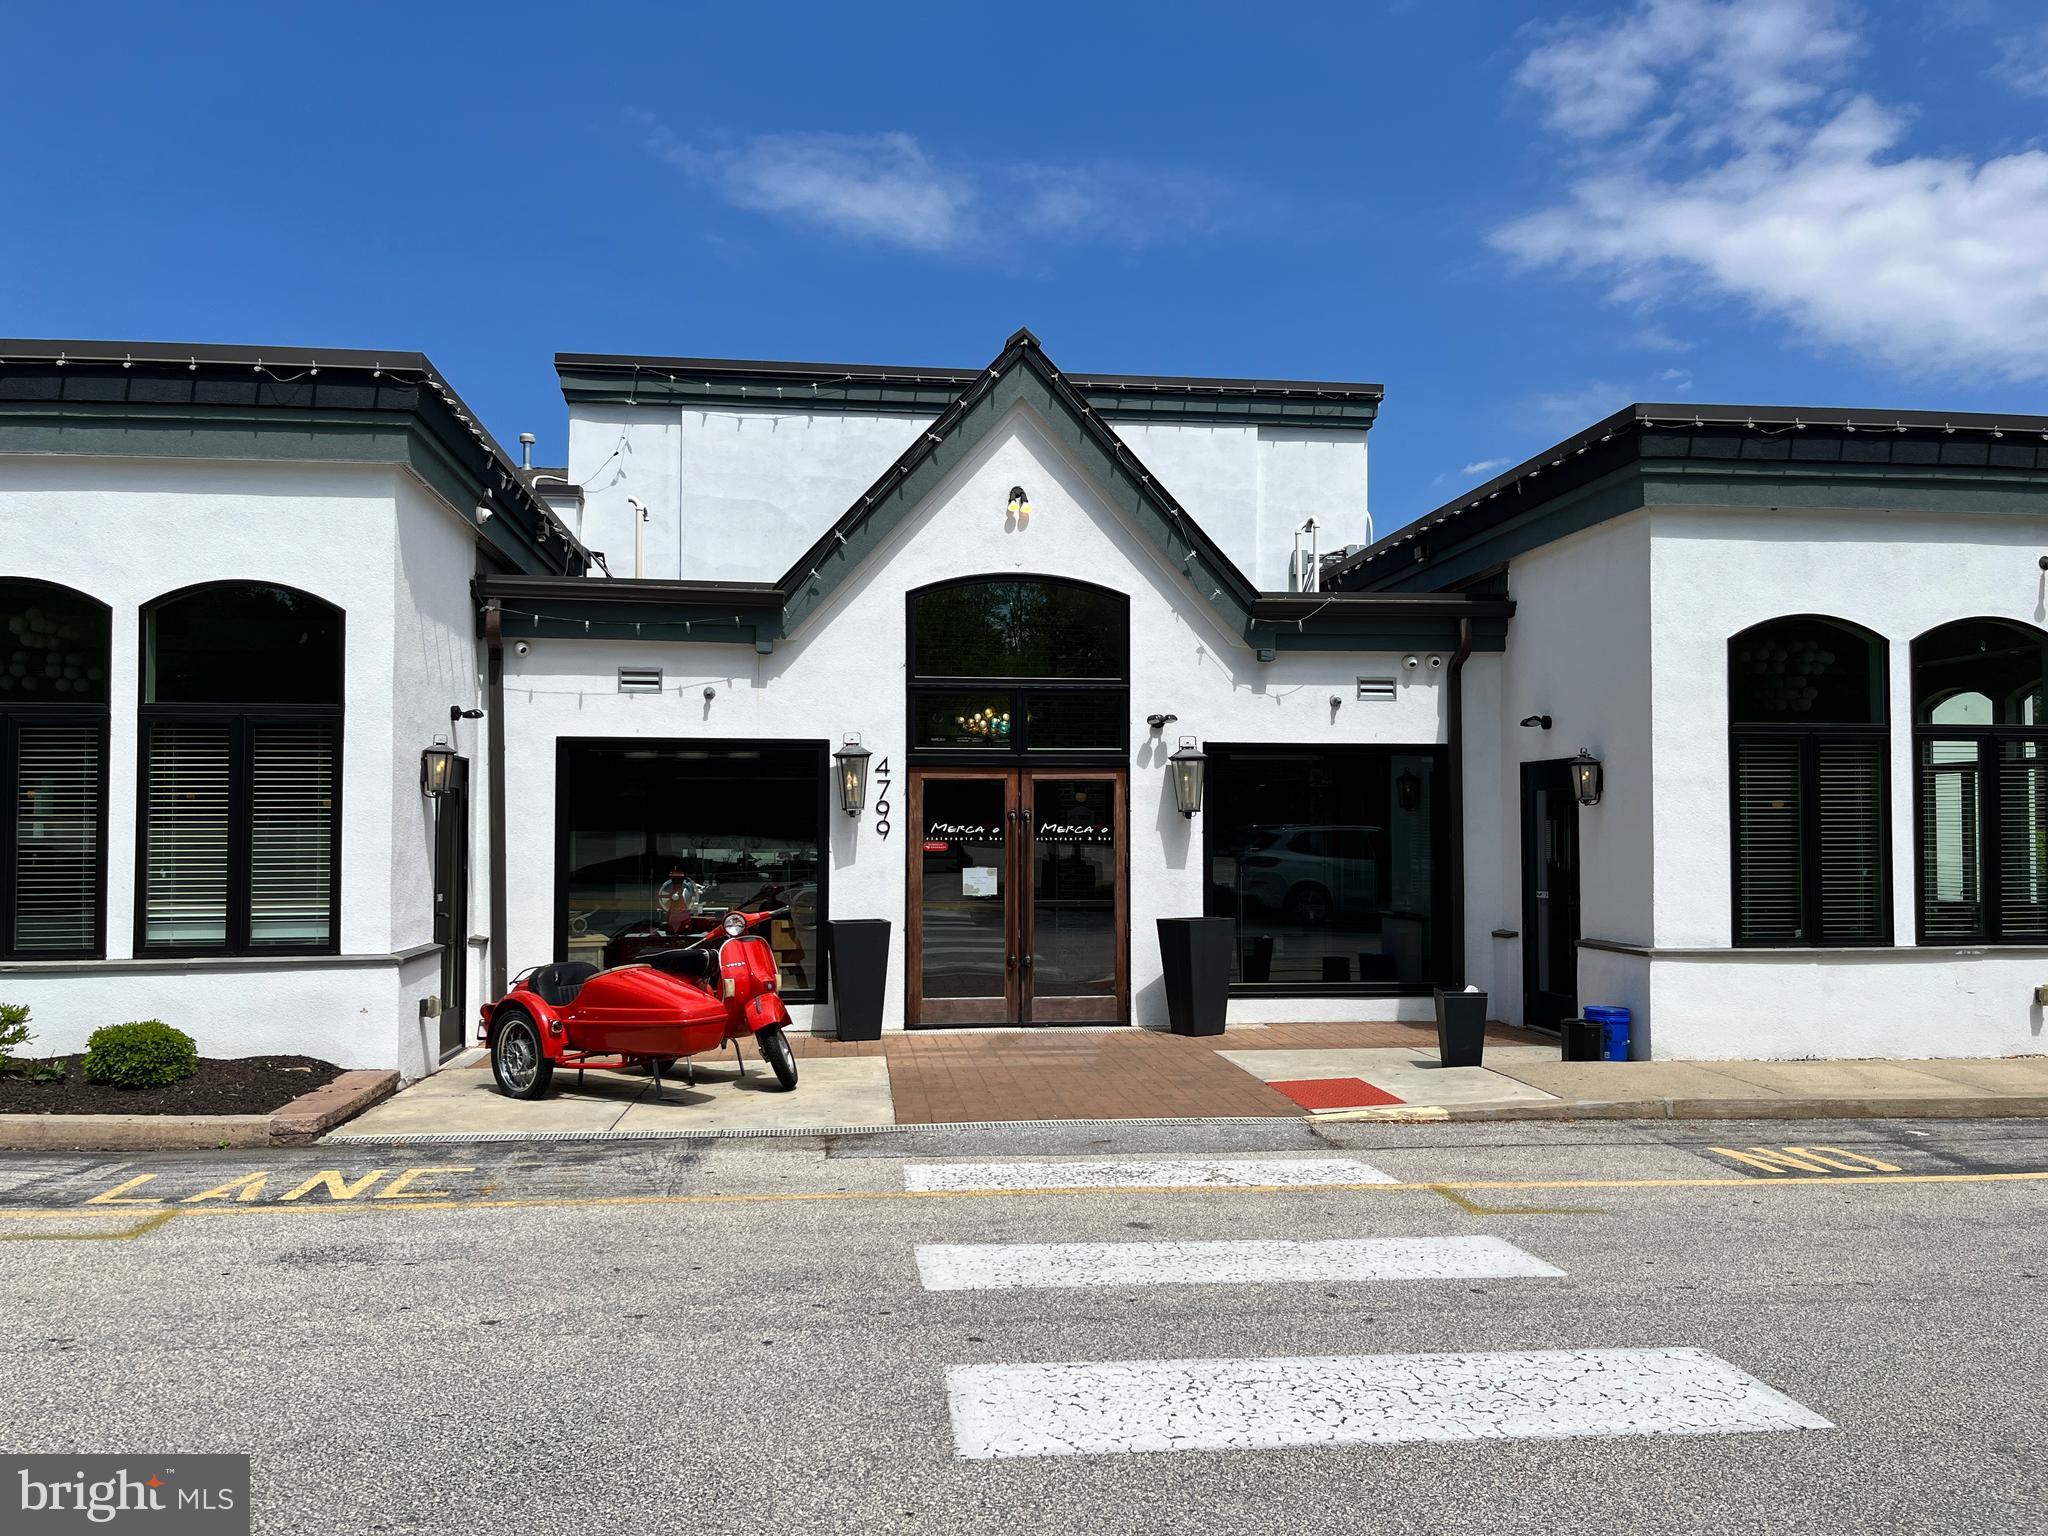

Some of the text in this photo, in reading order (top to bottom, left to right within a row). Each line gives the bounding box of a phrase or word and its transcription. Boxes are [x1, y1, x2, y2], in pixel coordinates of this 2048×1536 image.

[875, 756, 891, 842] 4799
[1707, 1146, 1902, 1173] NO
[85, 1167, 476, 1204] LANE
